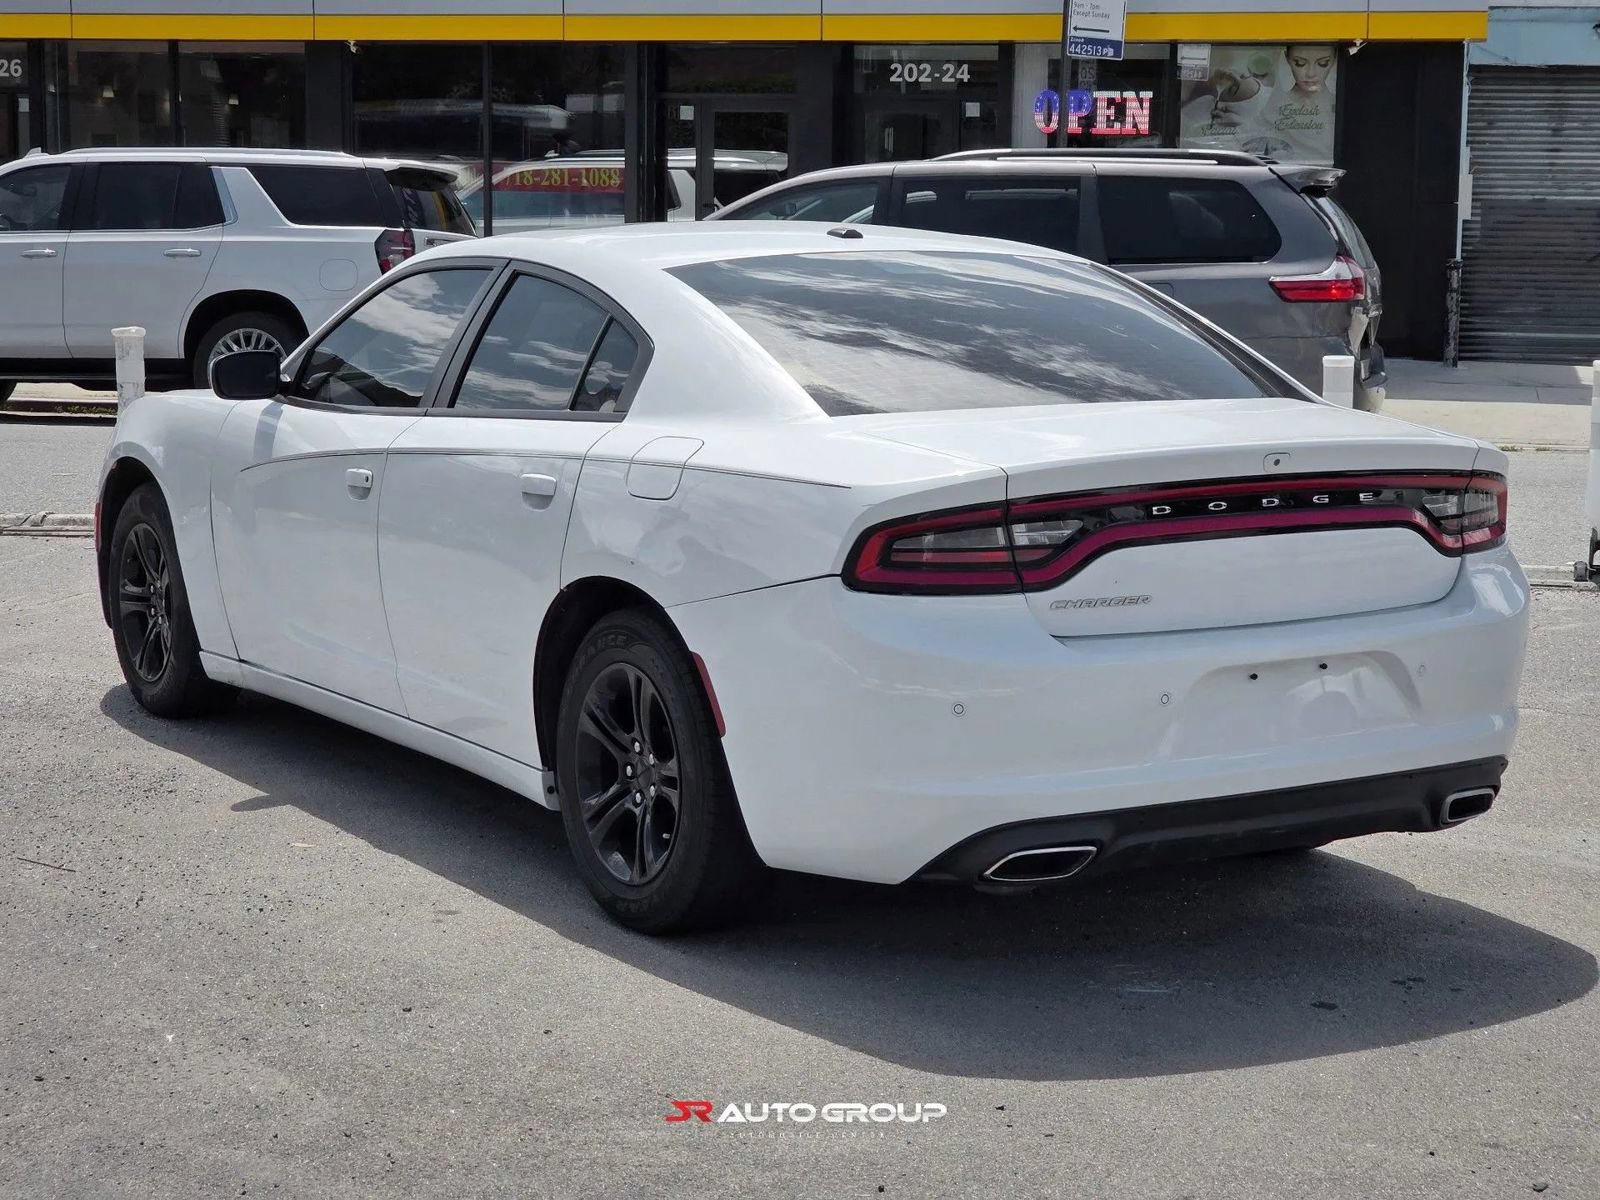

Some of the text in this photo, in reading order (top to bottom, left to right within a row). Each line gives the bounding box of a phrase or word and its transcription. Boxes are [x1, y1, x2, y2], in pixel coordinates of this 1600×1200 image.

[1073, 9, 1110, 19] Except Sunday
[1069, 43, 1102, 56] 442513
[889, 63, 970, 82] 202-24
[1034, 89, 1153, 134] OPEN
[1279, 103, 1320, 117] Eyelash
[1274, 117, 1324, 131] Extension
[1152, 492, 1375, 515] DODGE
[1049, 594, 1153, 610] CHARGER
